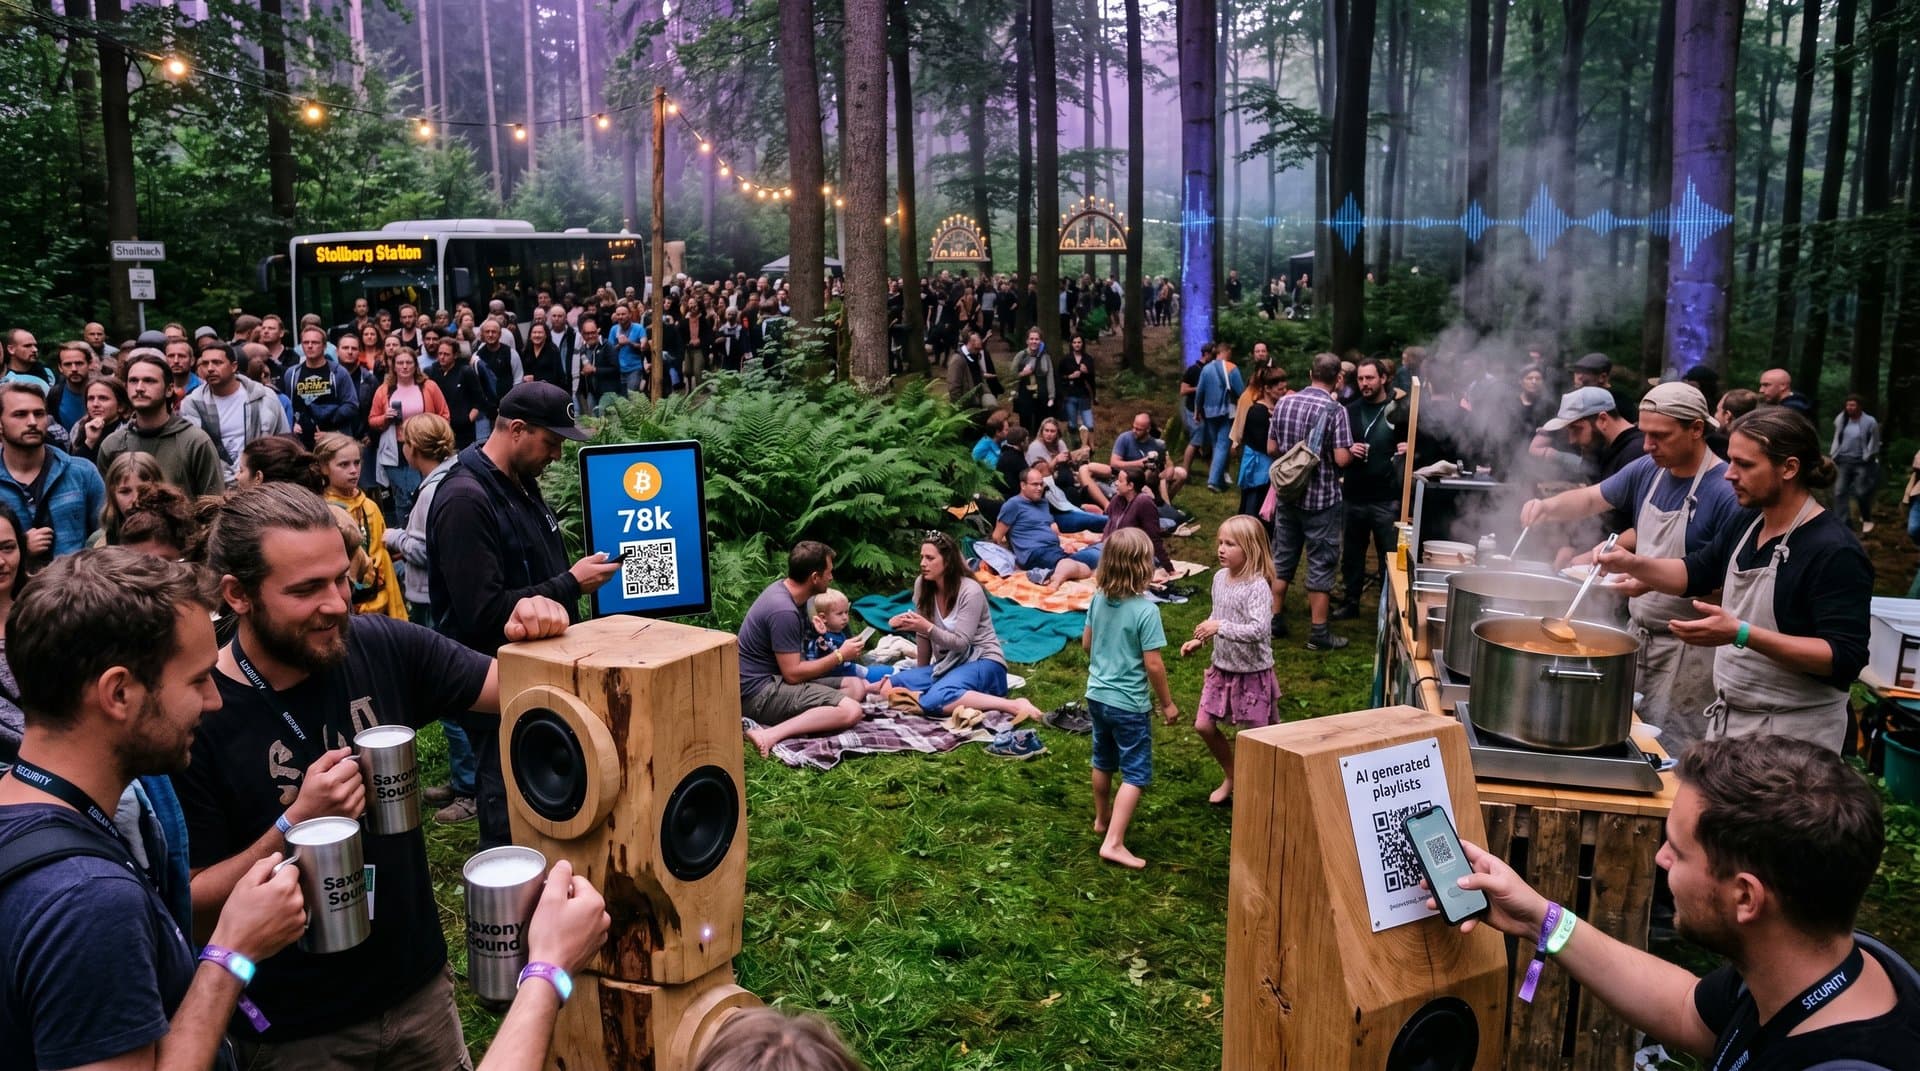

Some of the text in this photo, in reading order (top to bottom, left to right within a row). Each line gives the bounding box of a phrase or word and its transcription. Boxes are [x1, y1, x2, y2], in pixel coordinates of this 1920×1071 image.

[316, 244, 422, 263] Stollberg Station
[617, 505, 672, 534] 78k
[16, 764, 52, 786] SECURITY
[1355, 755, 1431, 785] AI generated
[1372, 777, 1421, 801] playlists
[328, 884, 366, 906] Soun
[468, 916, 526, 939] axony
[1801, 971, 1848, 1010] SECURITY
